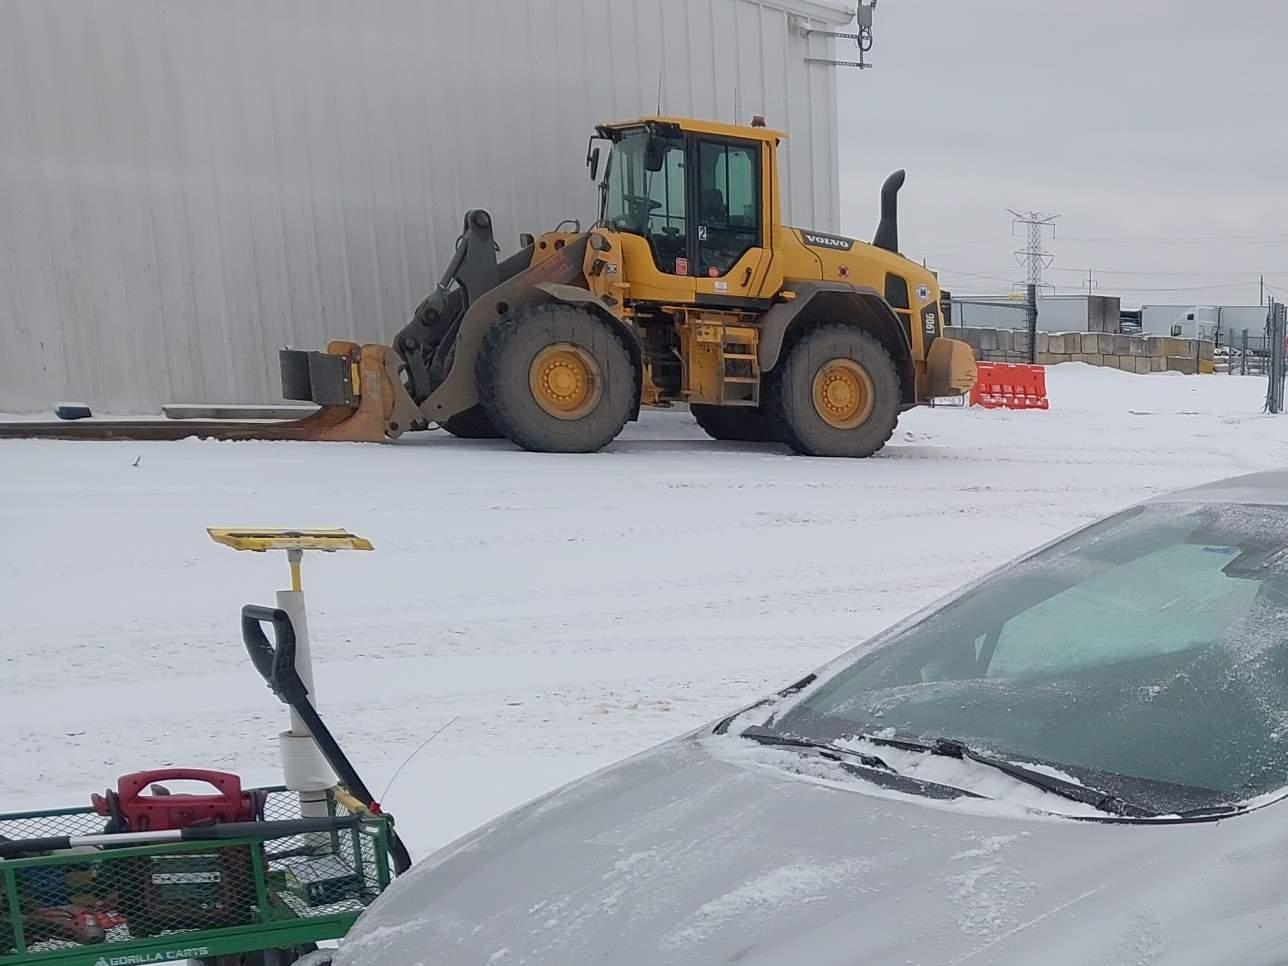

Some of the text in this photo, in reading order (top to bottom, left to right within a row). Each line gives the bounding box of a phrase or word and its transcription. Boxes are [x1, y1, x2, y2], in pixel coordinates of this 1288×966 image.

[805, 234, 849, 248] VOLVO
[925, 313, 935, 334] L90G
[110, 946, 209, 966] GORILLA CARTS
